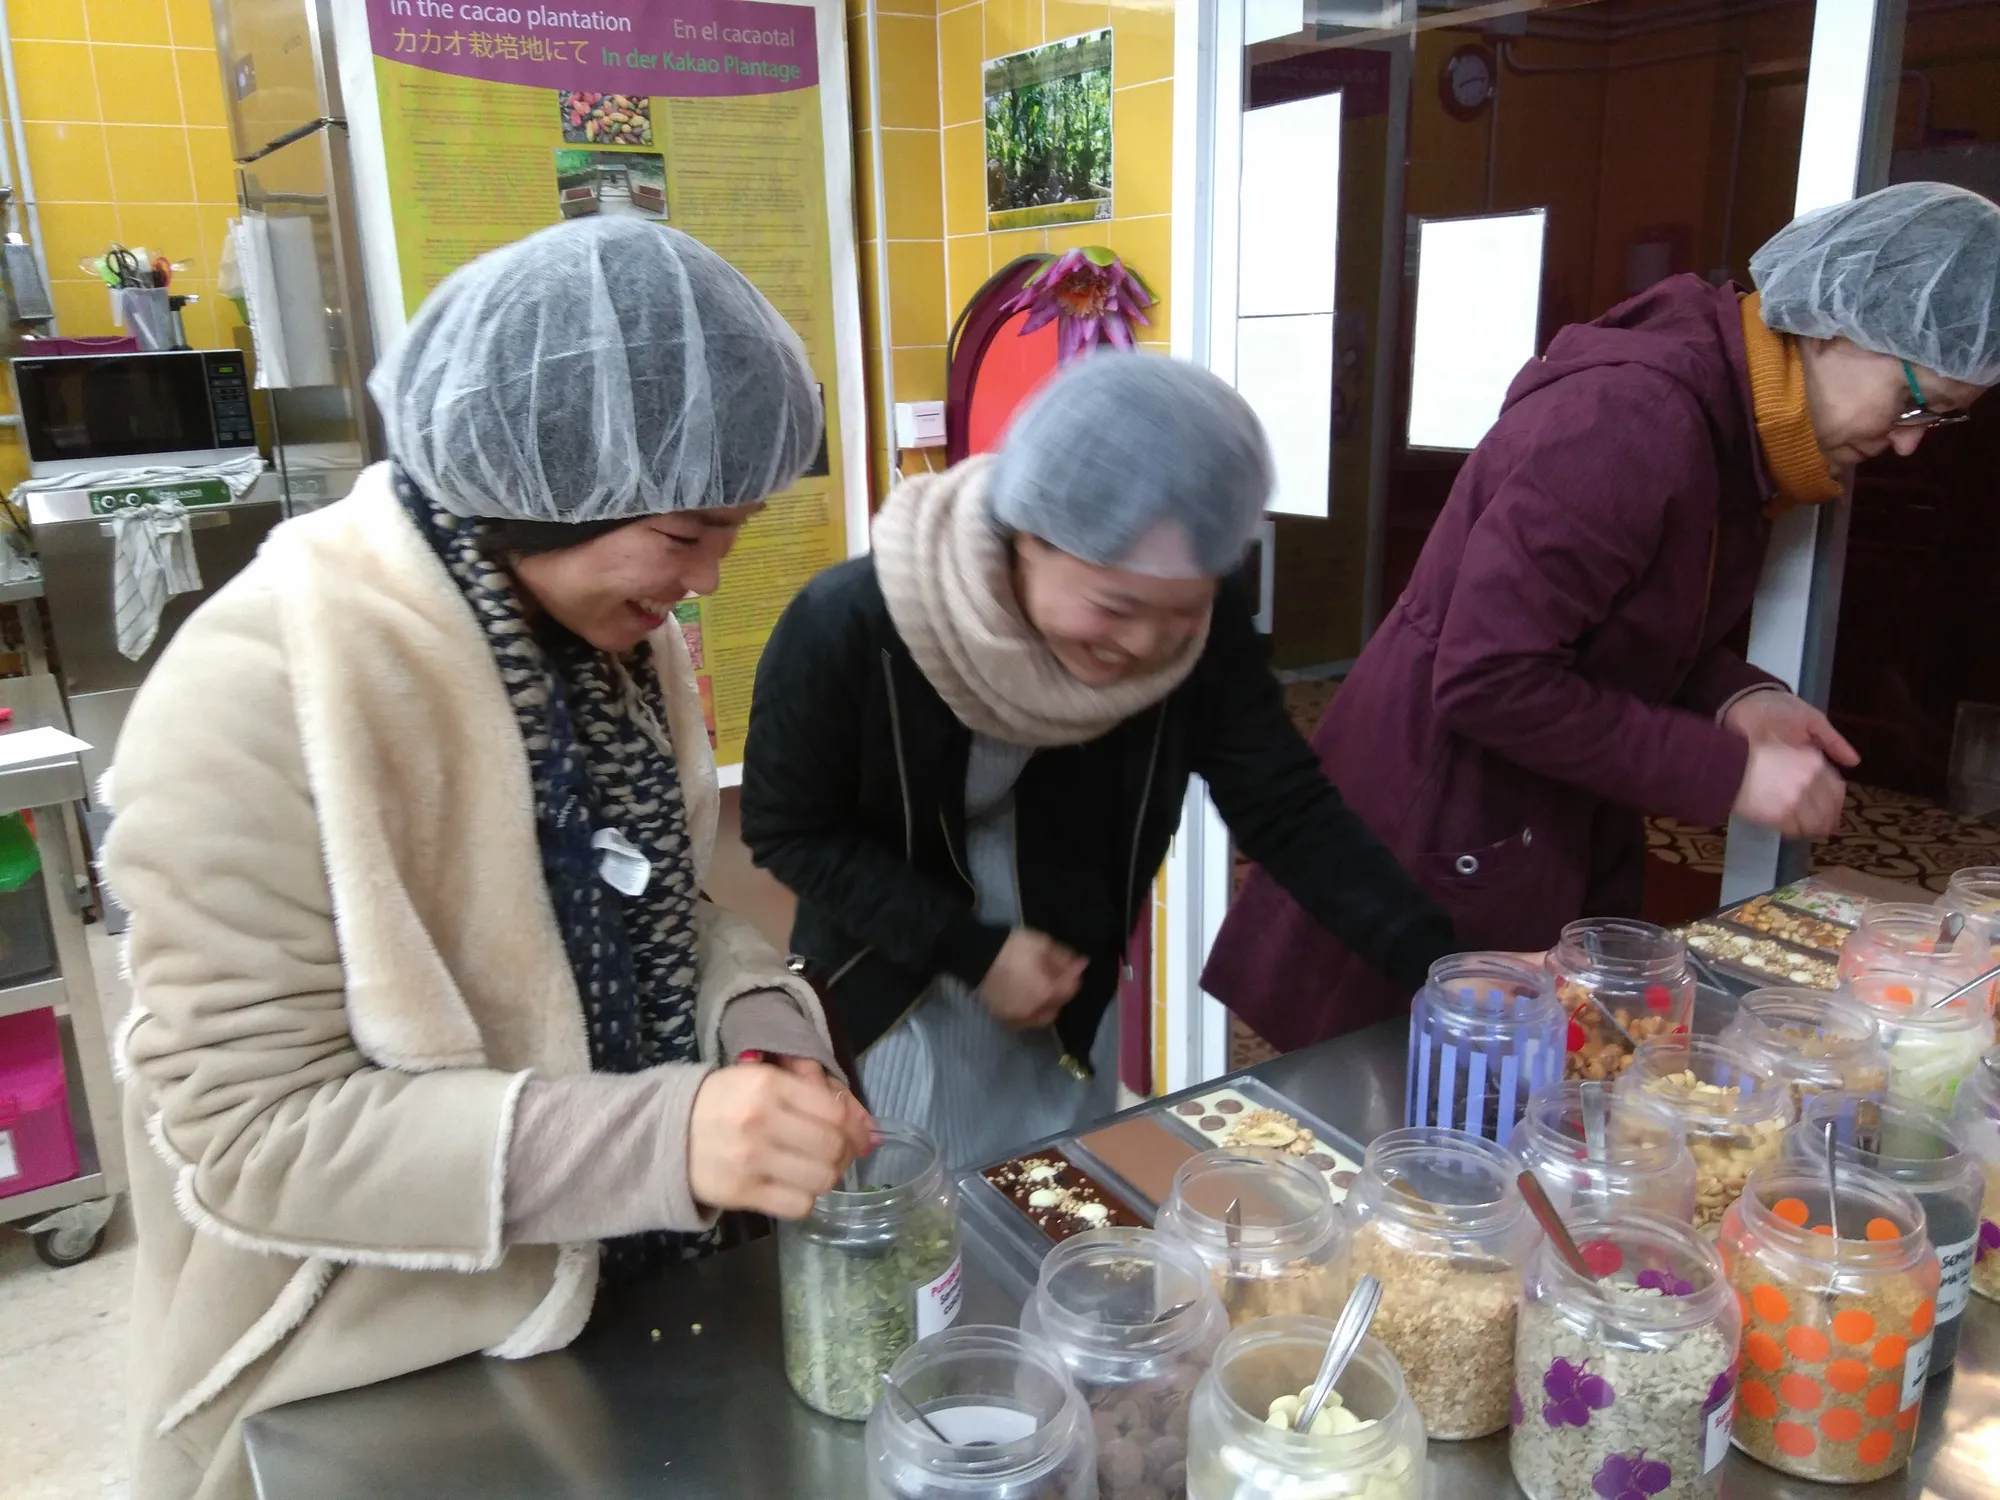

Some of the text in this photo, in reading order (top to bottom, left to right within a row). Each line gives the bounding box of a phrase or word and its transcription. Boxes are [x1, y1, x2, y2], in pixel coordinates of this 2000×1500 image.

[389, 0, 632, 32] In the cacao plantation
[673, 19, 795, 47] En el cacaotal
[394, 27, 589, 65] カカオ栽培地にて
[601, 47, 801, 83] In der Kakao Plantage
